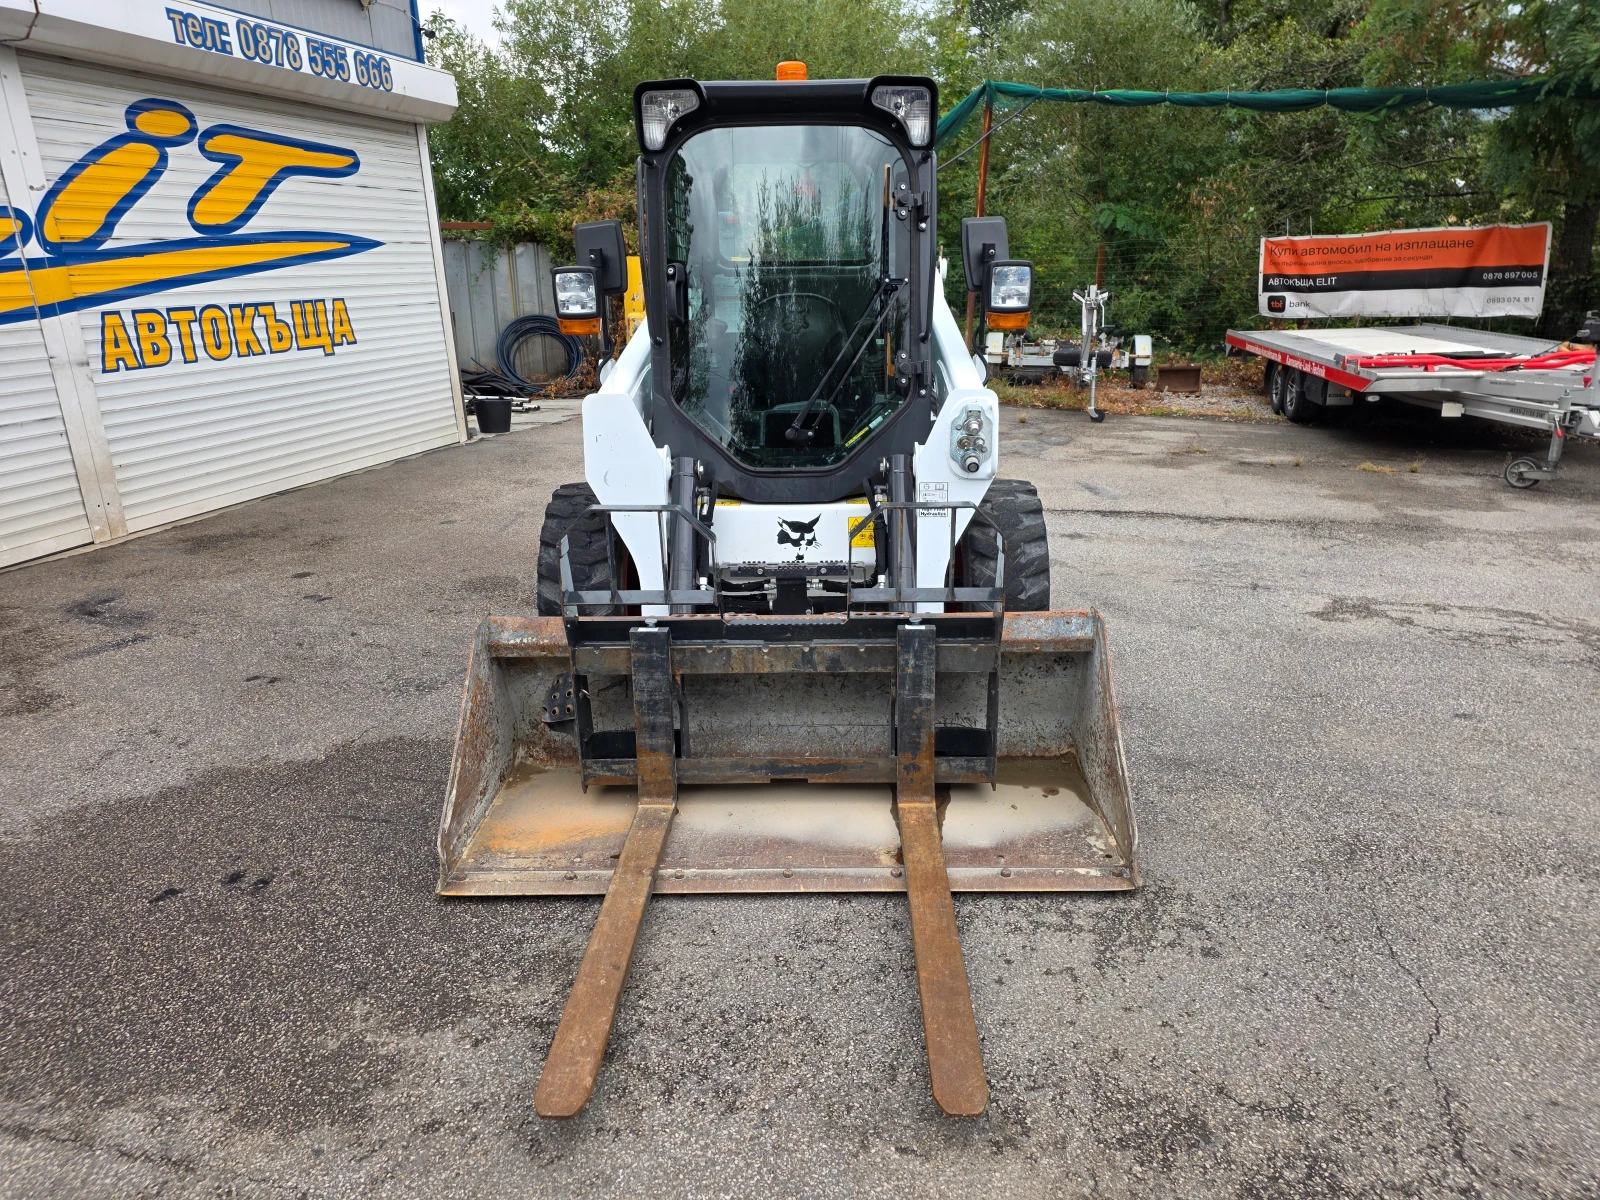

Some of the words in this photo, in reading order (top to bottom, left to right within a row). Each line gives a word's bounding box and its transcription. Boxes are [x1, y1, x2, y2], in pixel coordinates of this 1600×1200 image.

[166, 7, 233, 55] тел:
[236, 18, 302, 71] 0878
[306, 37, 350, 82] 555
[353, 50, 393, 92] 666
[1270, 246, 1298, 258] Купи
[1301, 244, 1371, 256] автомобил
[1375, 242, 1391, 251] на
[1395, 239, 1475, 251] изплащане
[1354, 256, 1393, 265] одобрение
[1402, 254, 1433, 262] секунди
[1482, 272, 1503, 280] 0878
[1521, 271, 1538, 279] 005
[1268, 277, 1314, 287] АВТОКЪЩА
[1316, 276, 1337, 287] ELIT
[1270, 300, 1283, 308] tbi
[1289, 300, 1310, 308] bank
[101, 298, 357, 373] АВТОКЪЩА
